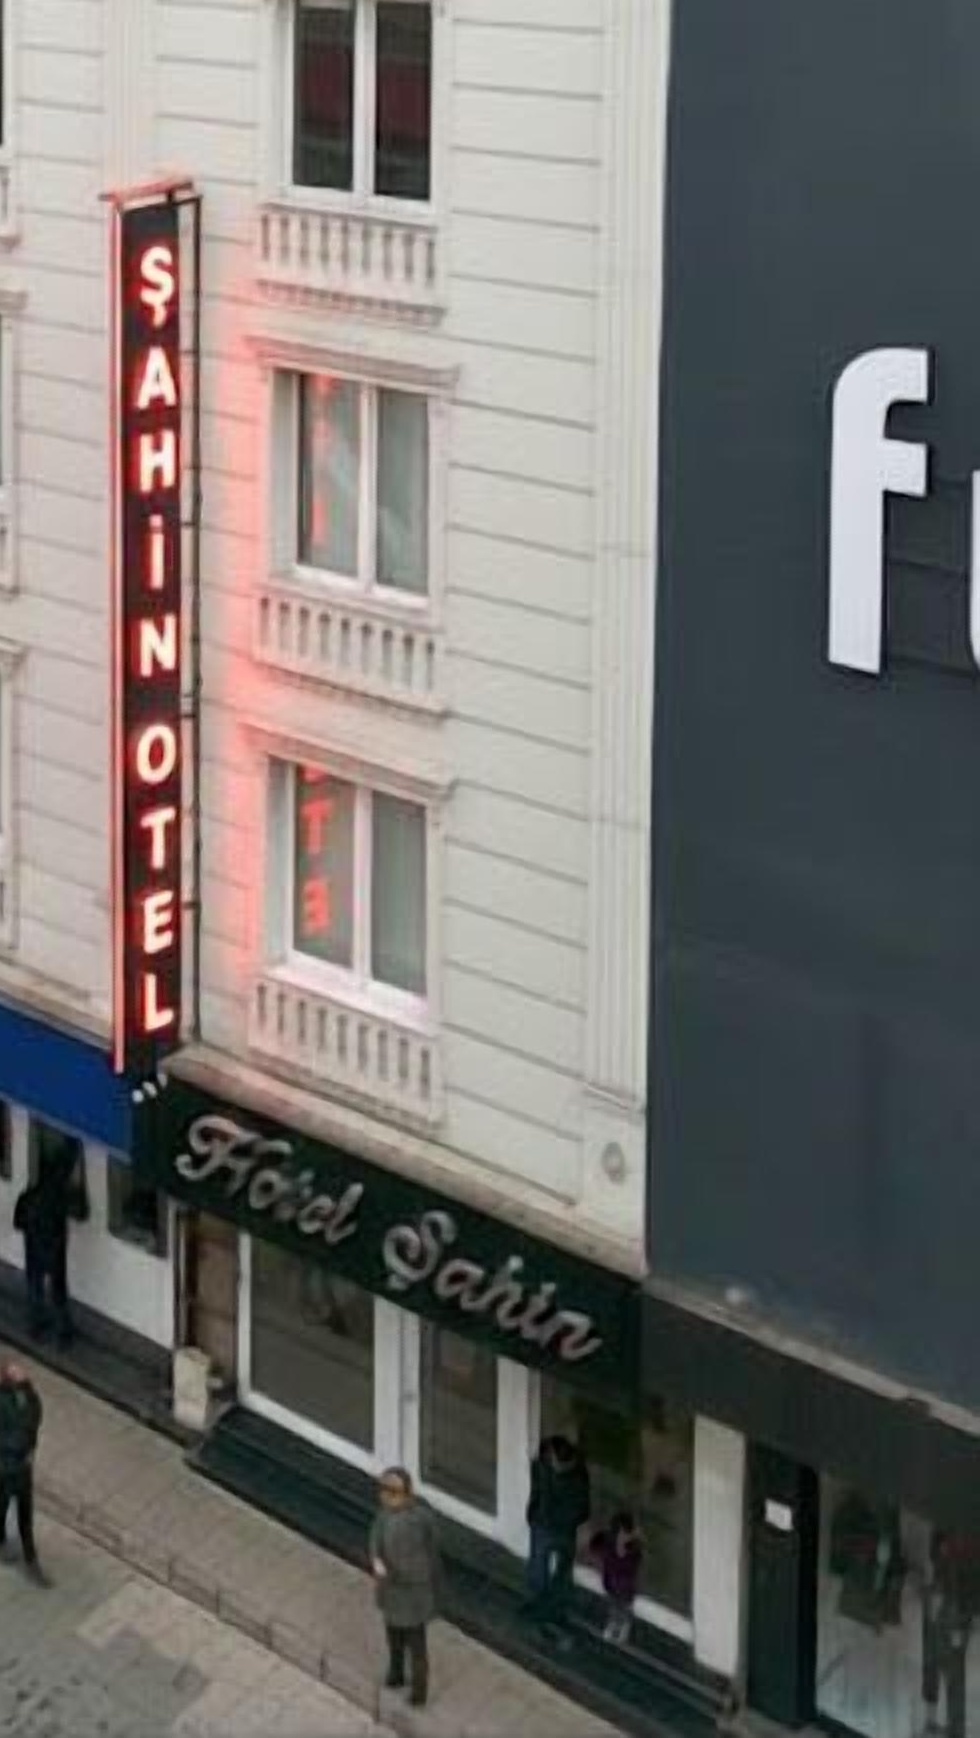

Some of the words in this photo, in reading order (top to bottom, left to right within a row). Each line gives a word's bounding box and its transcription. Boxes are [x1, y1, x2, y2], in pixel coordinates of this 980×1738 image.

[133, 243, 179, 679] ŞAHİN
[828, 346, 980, 674] f
[133, 722, 178, 1033] OTEL
